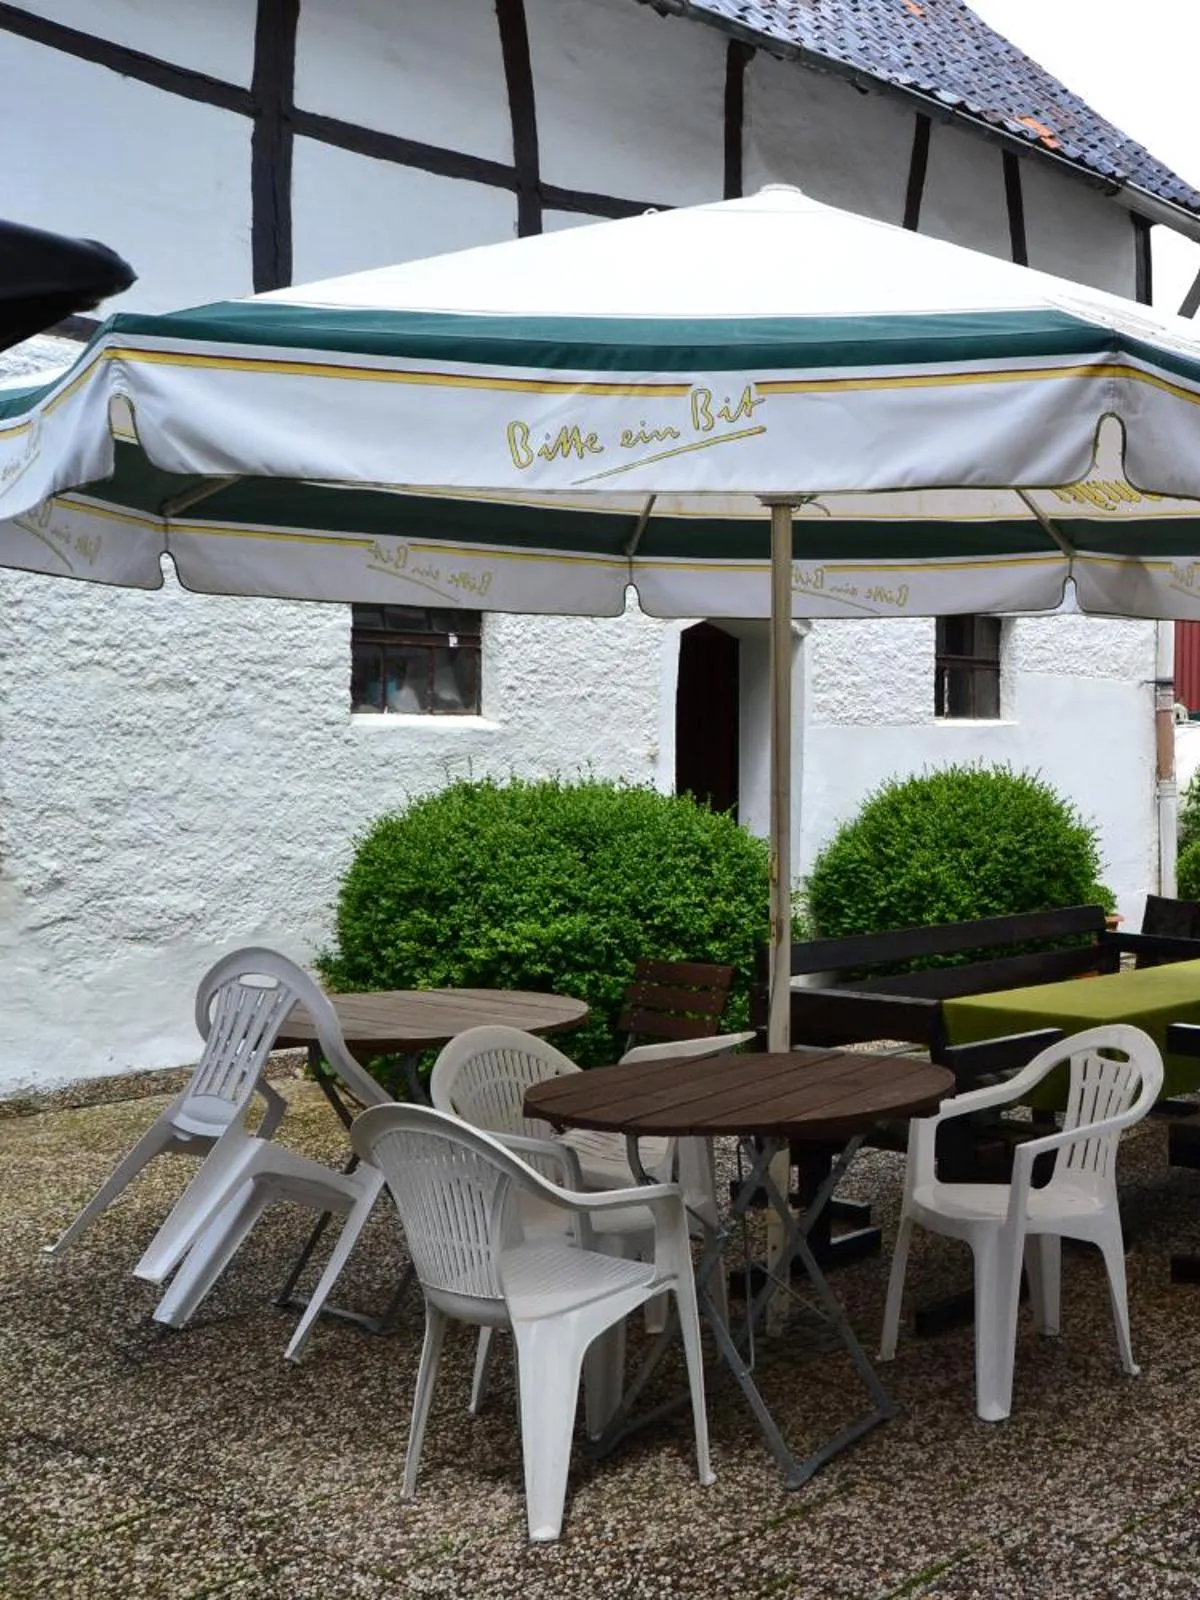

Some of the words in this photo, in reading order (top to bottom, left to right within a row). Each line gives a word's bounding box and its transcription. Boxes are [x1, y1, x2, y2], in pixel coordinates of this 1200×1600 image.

[507, 419, 604, 469] Bitte
[620, 420, 681, 448] ein
[690, 386, 766, 431] Bit
